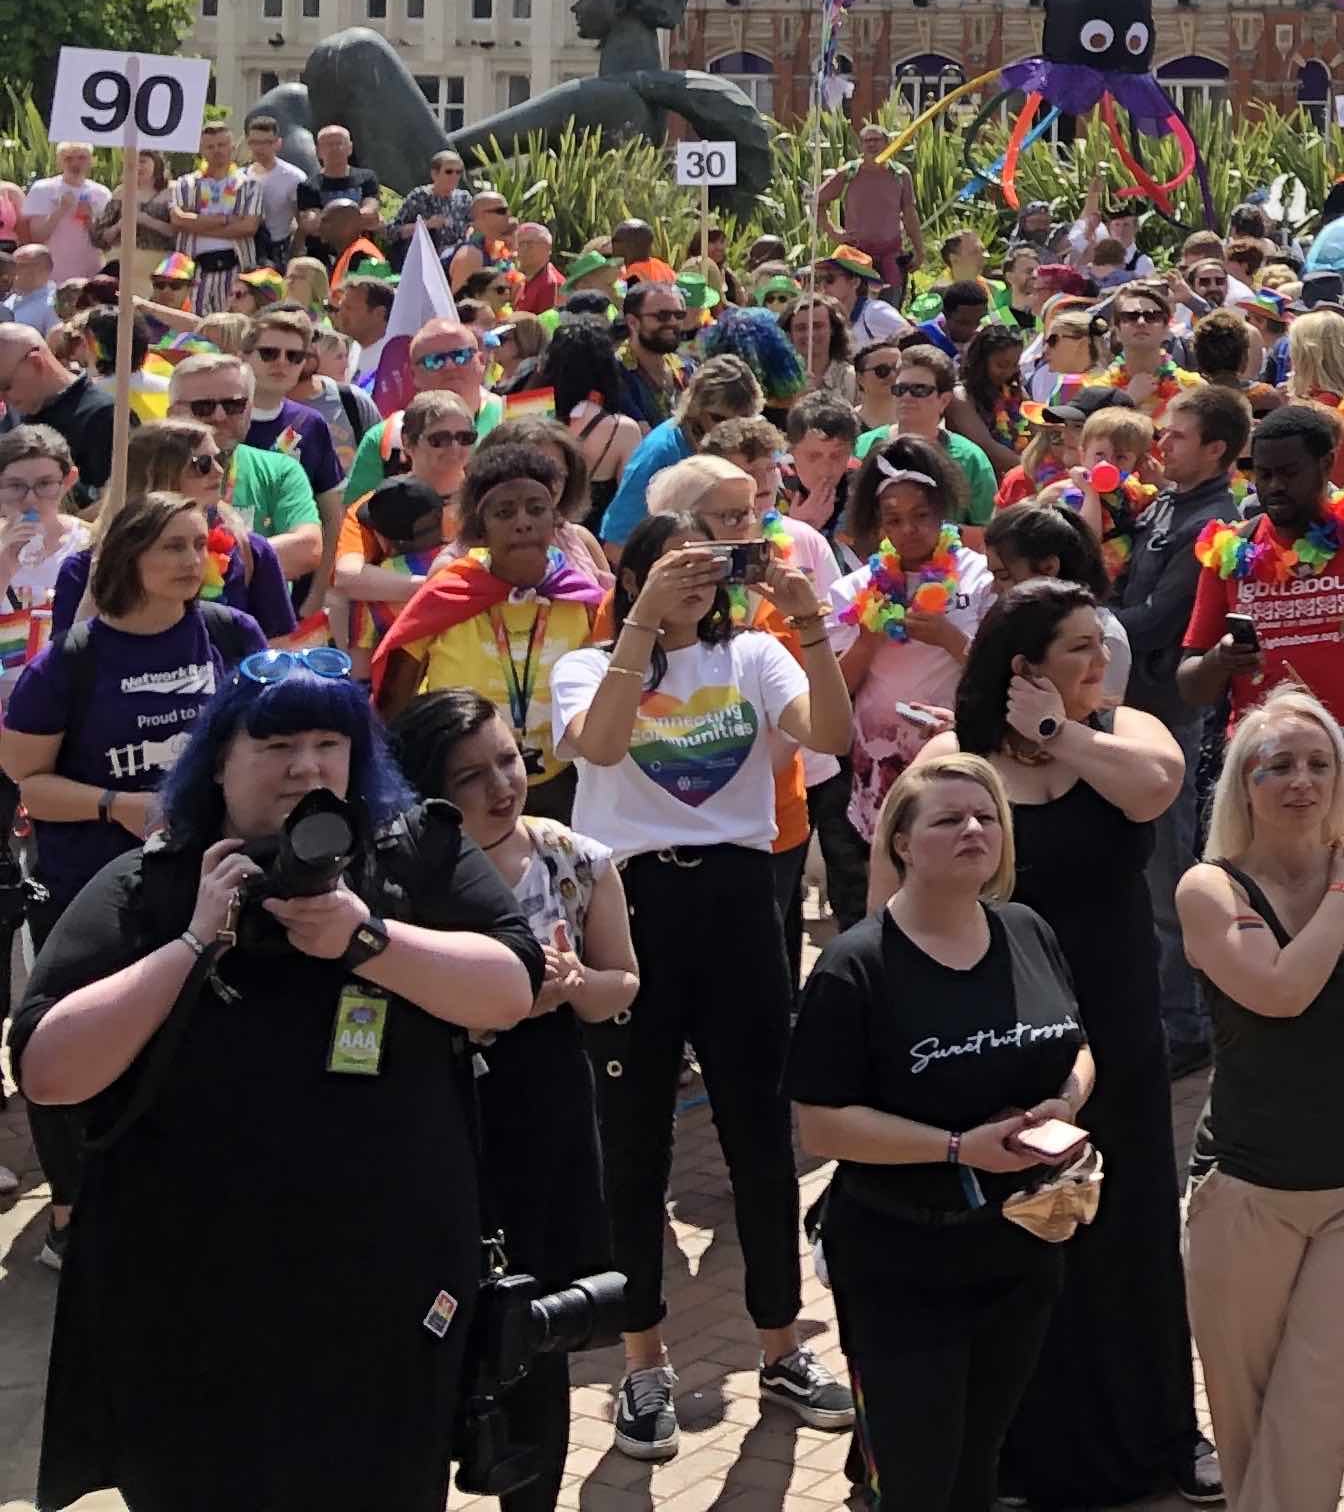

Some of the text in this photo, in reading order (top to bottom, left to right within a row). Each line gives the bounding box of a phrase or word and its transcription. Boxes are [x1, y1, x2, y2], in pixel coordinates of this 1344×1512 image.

[80, 70, 184, 136] 90
[686, 151, 726, 178] 30
[137, 709, 178, 728] Proud
[180, 708, 196, 720] to
[339, 1030, 377, 1049] AAA
[910, 1031, 985, 1074] Sweet
[985, 1022, 1031, 1047] but
